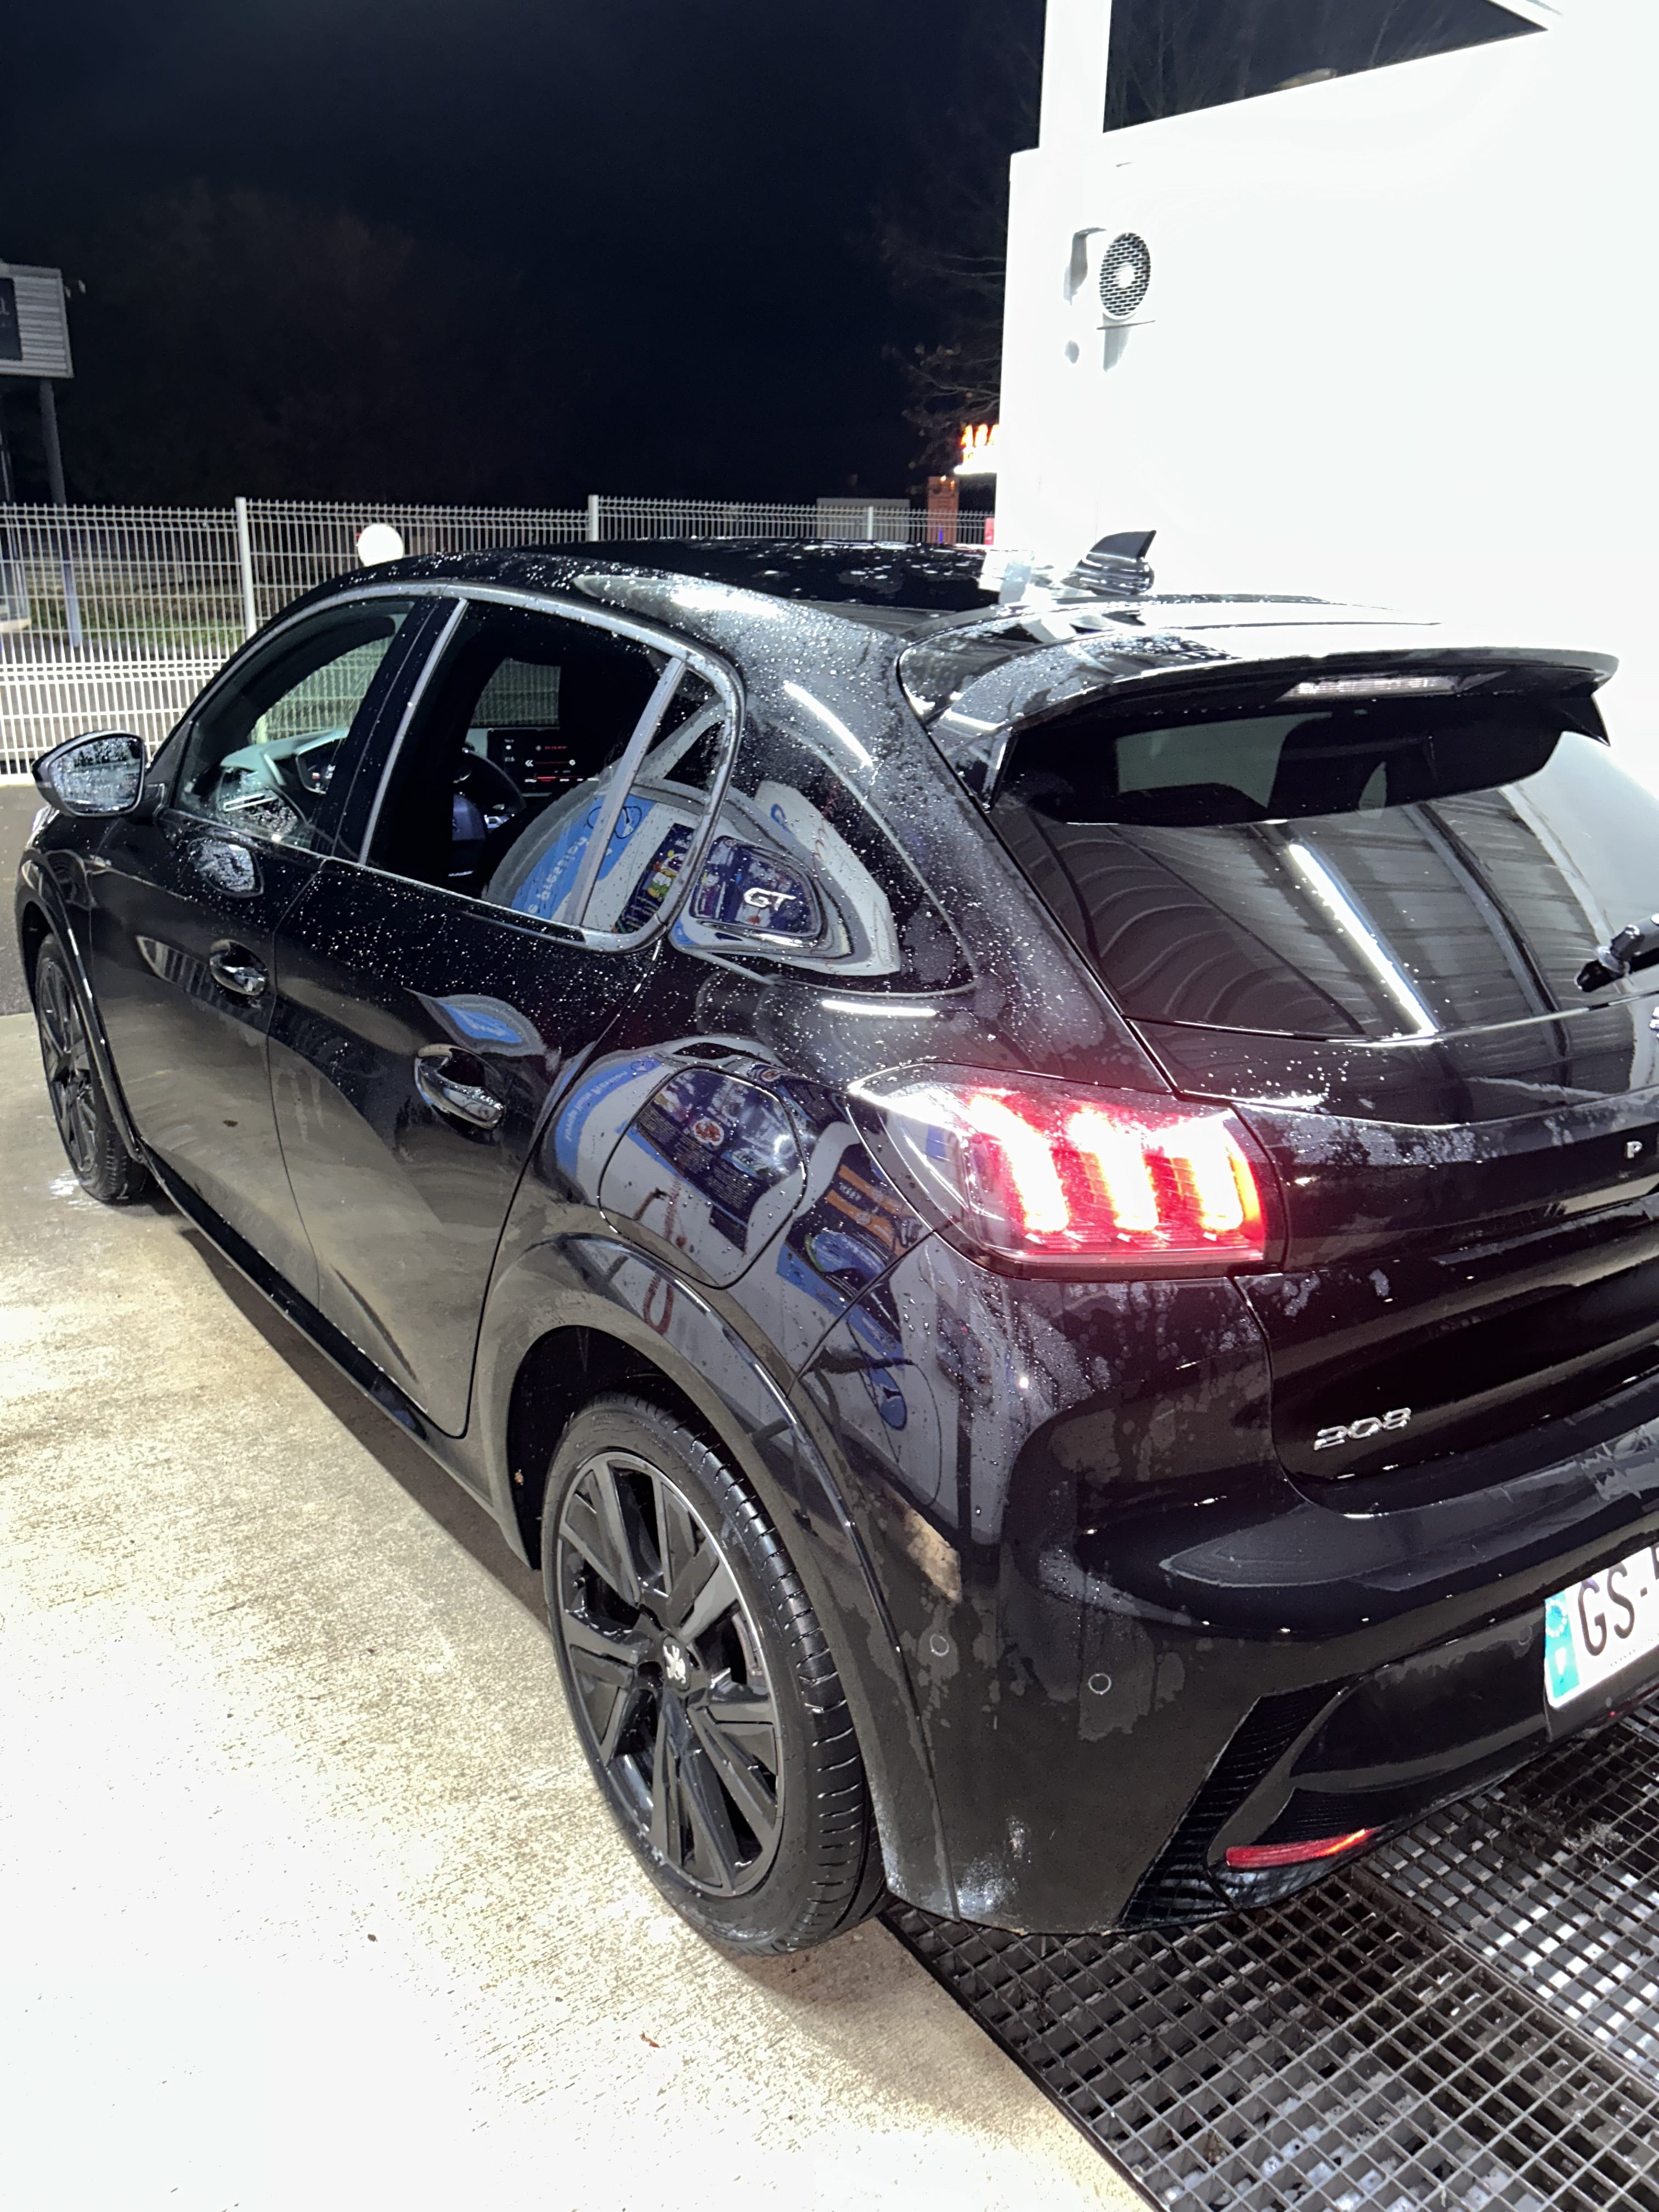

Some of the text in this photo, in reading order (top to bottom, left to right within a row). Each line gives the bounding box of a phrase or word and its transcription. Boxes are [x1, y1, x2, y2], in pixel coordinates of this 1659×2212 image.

[743, 887, 797, 911] GT
[1627, 1141, 1643, 1159] P
[1313, 1407, 1411, 1451] 208
